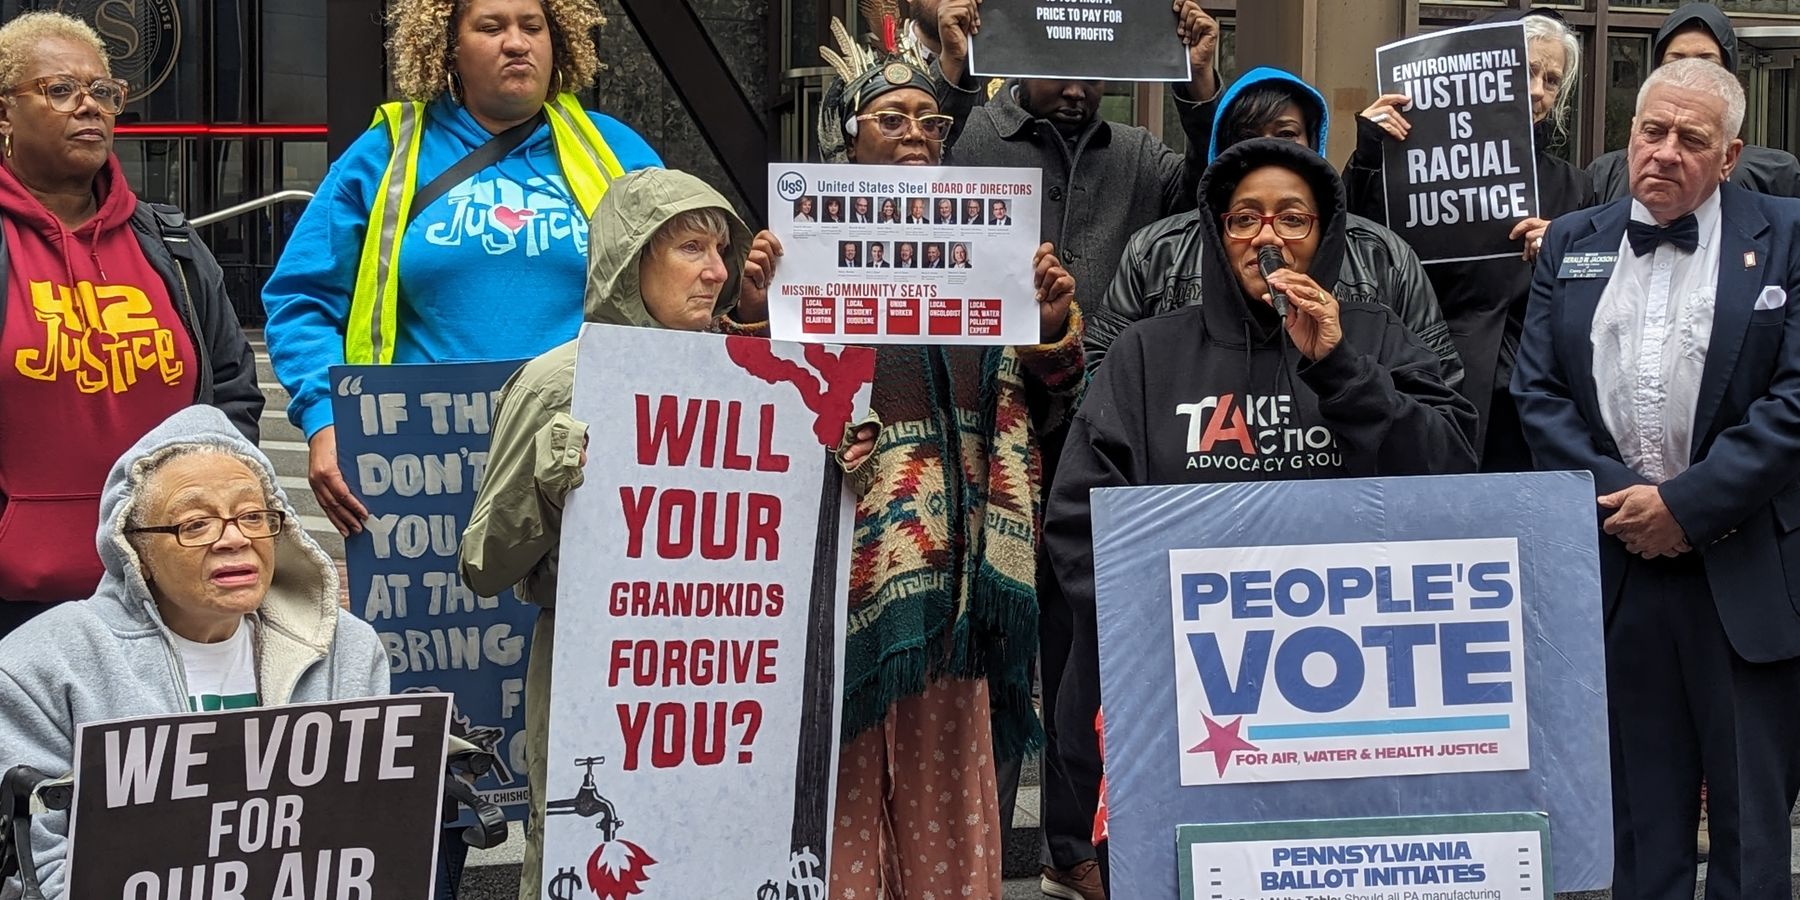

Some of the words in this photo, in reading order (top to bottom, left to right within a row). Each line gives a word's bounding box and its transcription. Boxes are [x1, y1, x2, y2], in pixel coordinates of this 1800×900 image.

[1036, 7, 1066, 21] PRICE
[1069, 8, 1080, 21] TO
[1082, 9, 1101, 22] PAY
[1103, 10, 1122, 23] FOR
[1046, 26, 1073, 40] YOUR
[1074, 27, 1114, 41] PROFITS
[1393, 49, 1520, 82] ENVIRONMENTAL
[1402, 69, 1514, 112] JUSTICE
[1449, 112, 1473, 139] IS
[1407, 140, 1520, 184] RACIAL
[817, 181, 855, 192] United
[859, 181, 894, 193] States
[898, 182, 928, 194] Steel
[931, 183, 963, 194] BOARD
[965, 183, 977, 194] OF
[980, 184, 1032, 195] DIRECTORS
[1406, 183, 1529, 228] JUSTICE
[29, 279, 160, 333] 412
[781, 285, 823, 296] MISSING:
[826, 283, 897, 297] COMMUNITY
[900, 284, 937, 297] SEATS
[635, 394, 789, 473] WILL
[1186, 455, 1285, 472] ADVOCACY
[362, 514, 457, 558] YOU
[619, 486, 781, 561] YOUR
[365, 574, 411, 621] AT
[609, 581, 784, 617] GRANDKIDS
[1181, 561, 1514, 621] PEOPLE'S
[379, 624, 525, 674] BRING
[608, 639, 779, 687] FORGIVE
[1186, 620, 1513, 716] VOTE
[104, 721, 217, 809] WE
[244, 704, 422, 791] VOTE
[616, 700, 763, 771] YOU?
[1235, 753, 1268, 766] FOR
[1271, 752, 1300, 766] AIR,
[1304, 749, 1357, 762] WATER
[1360, 748, 1372, 760] &
[1375, 746, 1434, 759] HEALTH
[1437, 742, 1498, 756] JUSTICE
[208, 794, 304, 857] FOR
[272, 847, 375, 900] AIR
[1272, 841, 1472, 867] PENNSYLVANIA
[1260, 868, 1358, 891] BALLOT
[1364, 863, 1486, 887] INITIATES
[1403, 891, 1418, 900] PA
[1422, 888, 1501, 900] manufacturing
